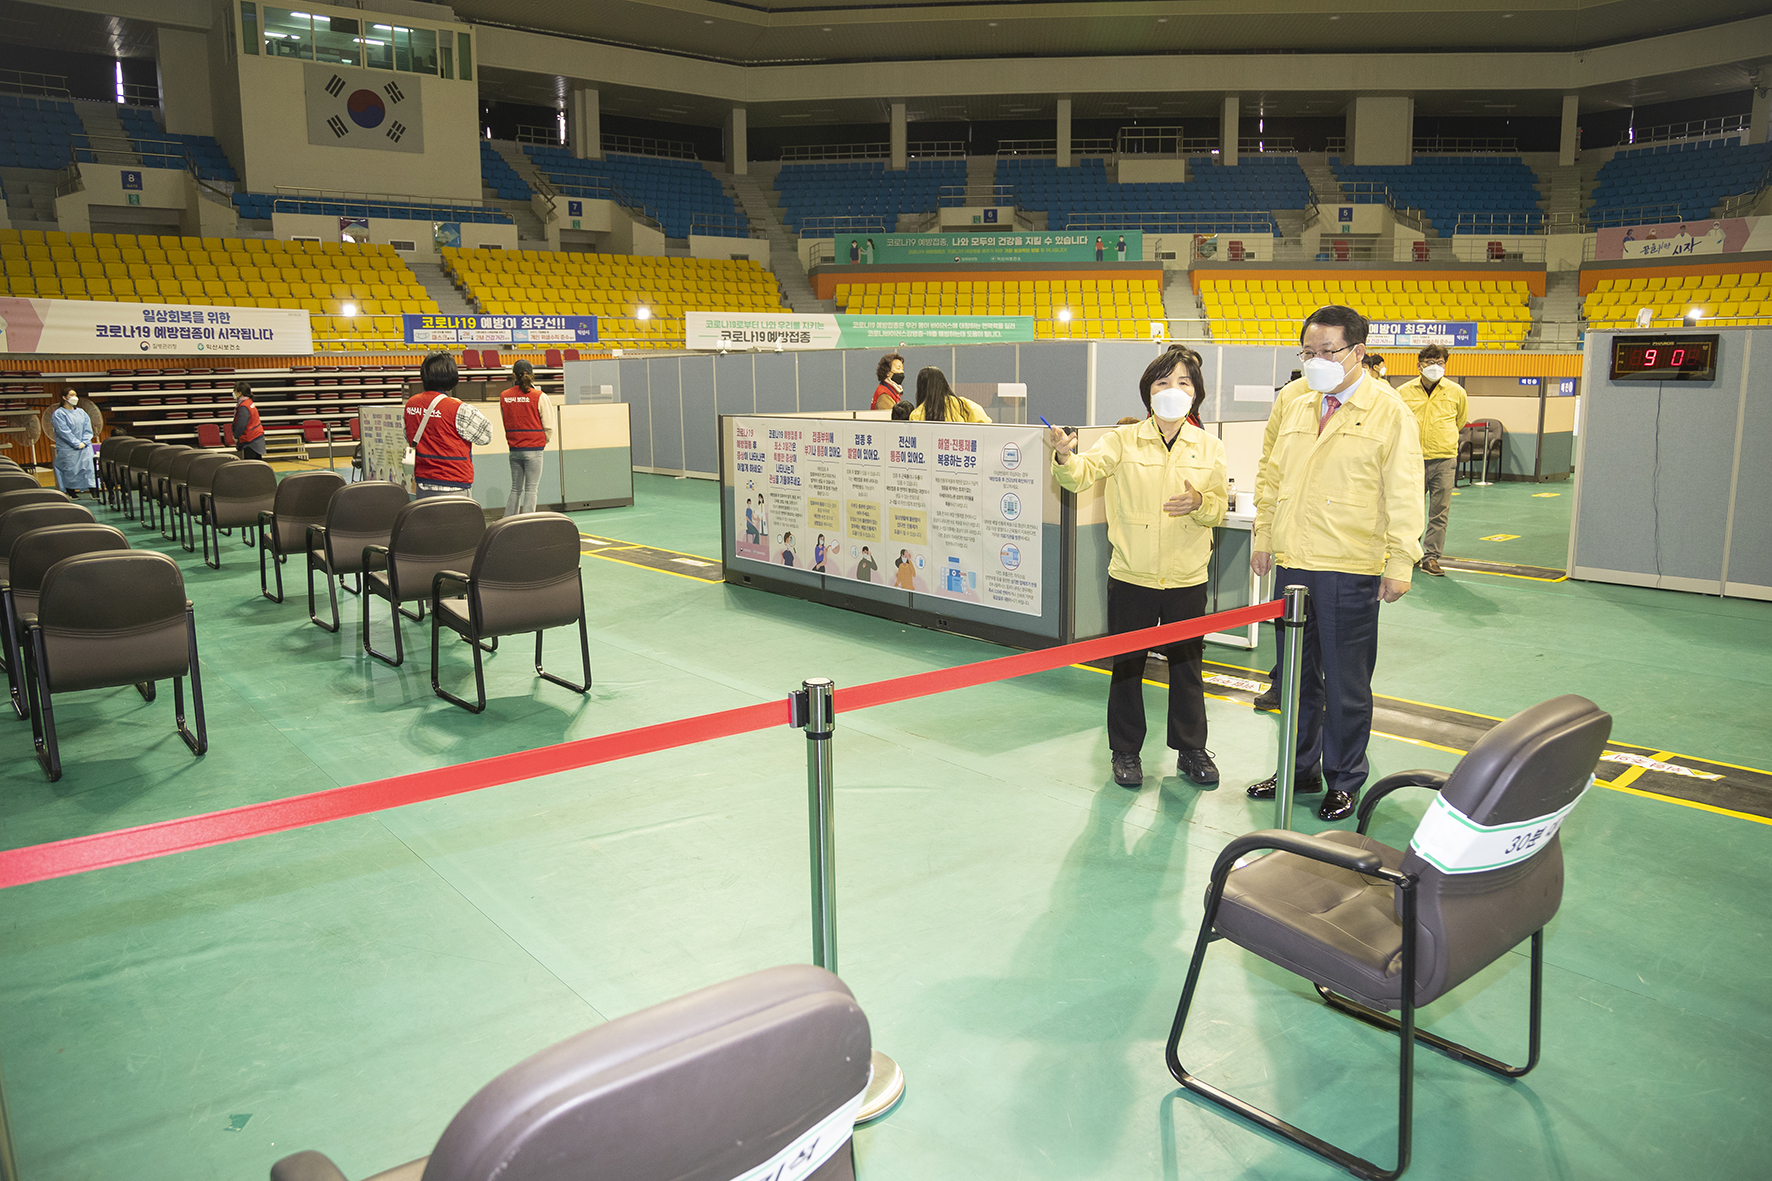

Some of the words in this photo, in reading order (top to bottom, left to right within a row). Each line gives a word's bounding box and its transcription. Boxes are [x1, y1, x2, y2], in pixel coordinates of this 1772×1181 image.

[128, 174, 135, 182] 8
[886, 238, 916, 246] 코로나19
[918, 238, 948, 246] 예방접종,
[952, 237, 969, 246] 나와
[971, 237, 996, 246] 모두의
[998, 236, 1023, 246] 건강을
[1025, 236, 1042, 245] 지킬
[1044, 236, 1052, 245] 수
[1055, 236, 1088, 245] 있습니다
[1672, 237, 1702, 256] 시작
[143, 310, 204, 324] 일상회복을
[207, 312, 230, 324] 위한
[422, 316, 476, 329] 코로나19
[480, 317, 517, 329] 예방이
[521, 317, 565, 329] 최우선!!
[706, 320, 759, 329] 코로나19로부터
[761, 321, 776, 329] 나와
[778, 321, 800, 329] 우리를
[802, 321, 824, 330] 지키는
[1369, 324, 1400, 334] 예방이
[1405, 324, 1446, 335] 최우선!!
[96, 325, 150, 338] 코로나19
[154, 327, 215, 340] 예방접종이
[218, 328, 274, 340] 시작됩니다
[721, 331, 765, 342] 코로나19
[767, 331, 810, 344] 예방접종
[406, 407, 422, 416] 익산시
[736, 428, 754, 437] 코로나19
[769, 430, 783, 438] 코로나19
[784, 431, 797, 440] 예방접종
[799, 431, 802, 440] 후
[812, 432, 834, 443] 접종부위에
[737, 440, 752, 449] 예방접종
[753, 441, 757, 449] 후
[855, 434, 865, 445] 접종
[867, 434, 872, 445] 후
[899, 436, 916, 448] 전신에
[737, 451, 748, 460] 증상이
[749, 452, 765, 462] 나타나면
[805, 445, 816, 456] 부기나
[817, 446, 828, 457] 통증이
[829, 446, 842, 457] 있어요.
[847, 448, 862, 460] 발열이
[863, 449, 880, 460] 있어요.
[786, 453, 797, 463] 증상이
[890, 451, 906, 463] 통증이
[908, 451, 925, 464] 있어요.
[938, 454, 962, 467] 복용하는
[964, 455, 976, 468] 경우
[737, 463, 748, 472] 이렇게
[776, 464, 794, 474] 나타나는지
[769, 474, 779, 484] 관심을
